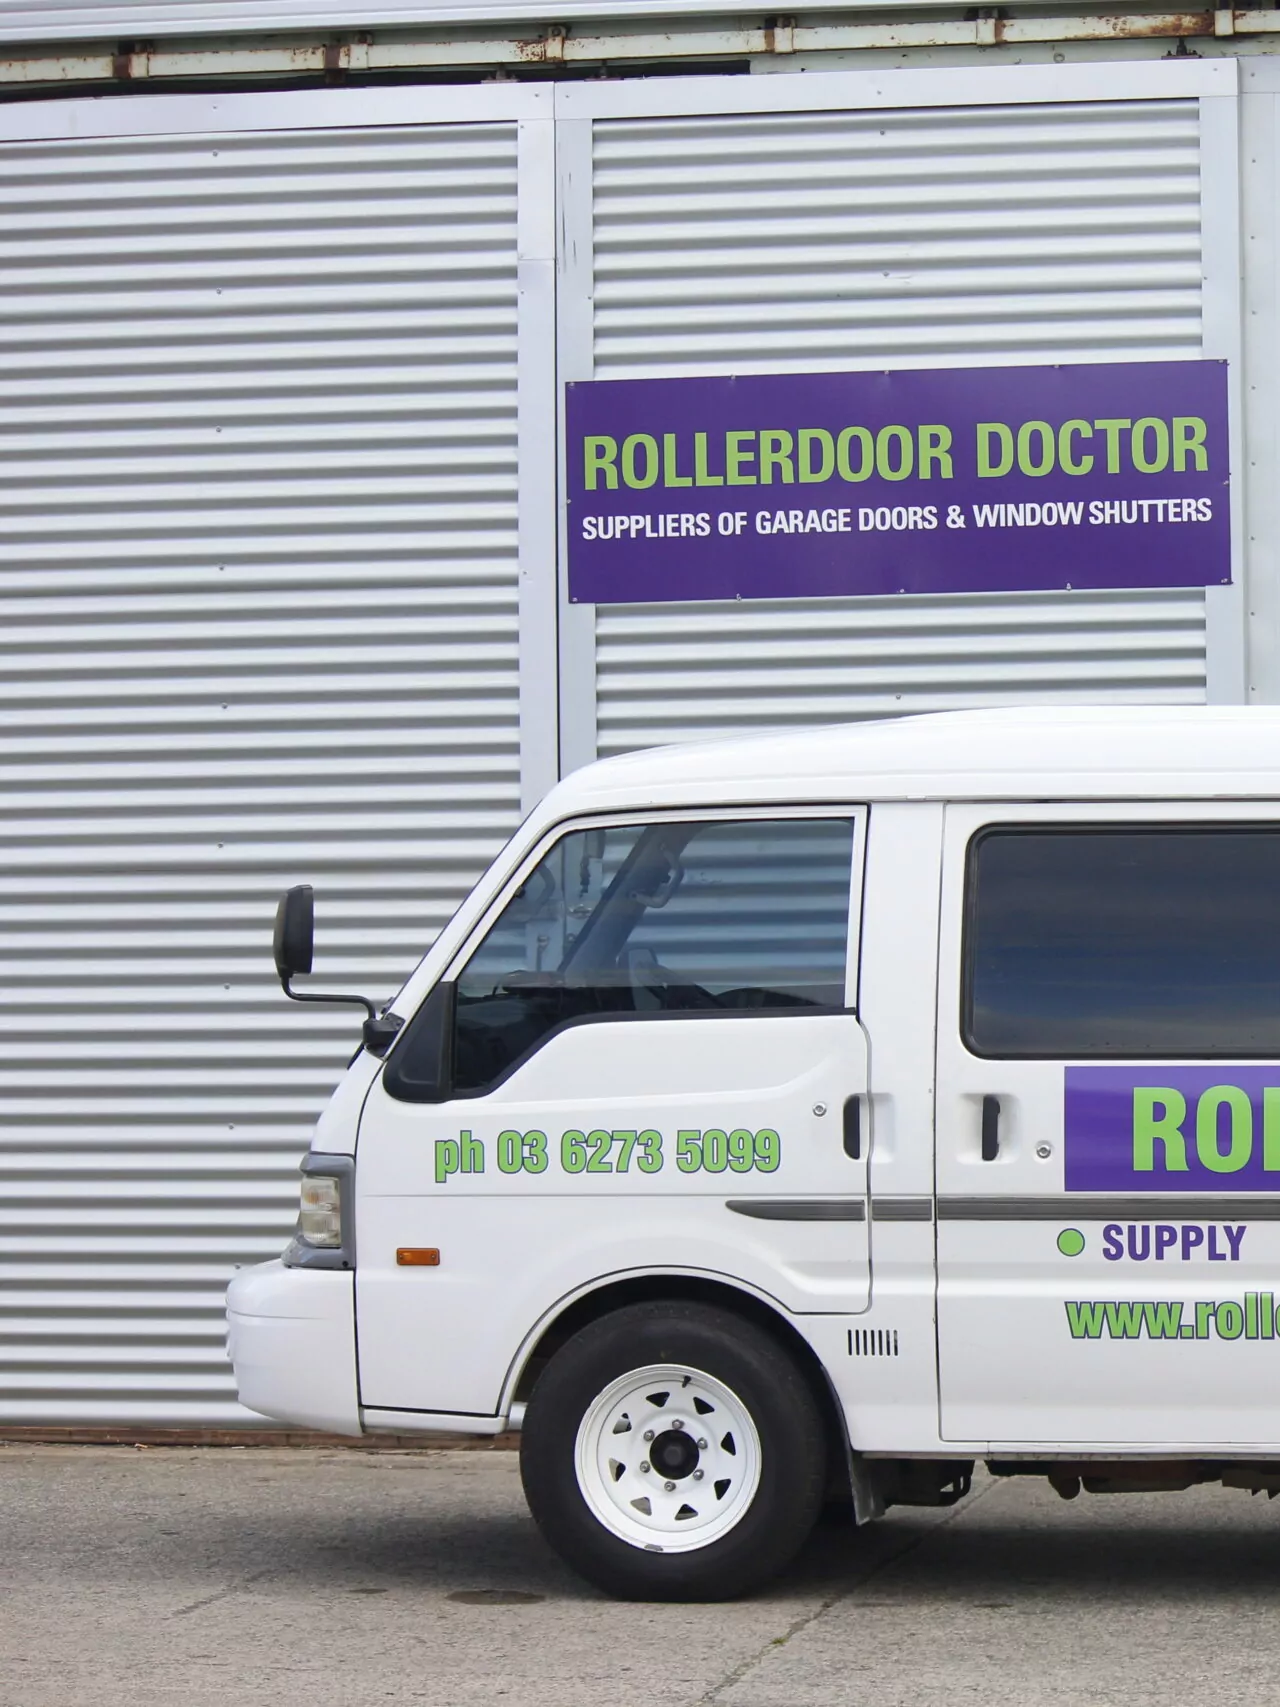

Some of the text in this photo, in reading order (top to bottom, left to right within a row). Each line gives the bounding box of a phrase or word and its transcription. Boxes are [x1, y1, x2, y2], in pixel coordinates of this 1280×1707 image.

[584, 416, 1208, 490] ROLLERDOOR DOCTOR
[583, 498, 1213, 540] SUPPLIERS OF GARAGE DOORS & WINDOW SHUTTERS
[434, 1129, 782, 1183] ph 03 6273 5099
[1102, 1224, 1247, 1262] SUPPLY
